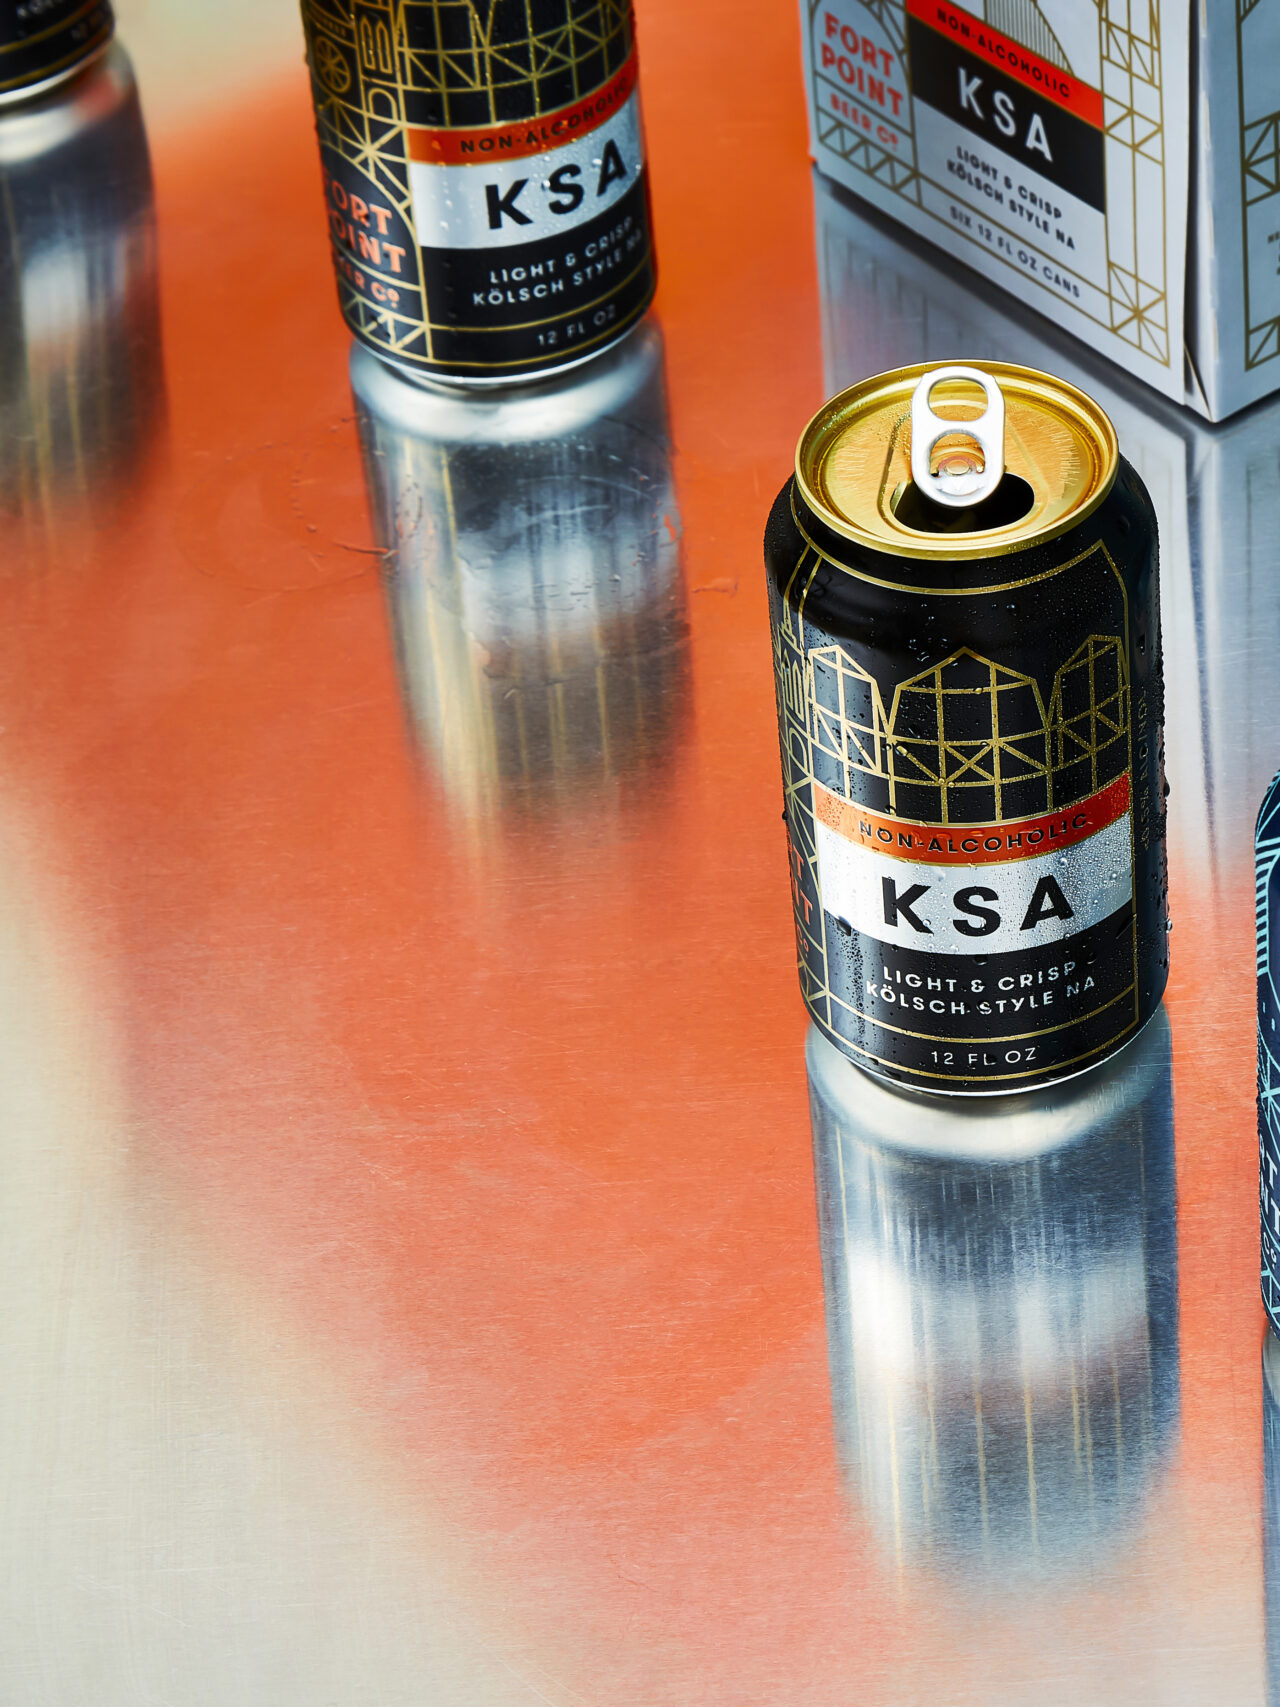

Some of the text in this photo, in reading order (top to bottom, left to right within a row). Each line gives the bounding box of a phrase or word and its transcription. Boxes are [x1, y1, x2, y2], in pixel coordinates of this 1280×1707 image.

[824, 11, 894, 78] FORT
[937, 8, 1070, 98] NON-ALCOHOLIC
[821, 42, 903, 117] POINT
[461, 77, 628, 153] NON-ALCOHOLIC
[830, 93, 872, 132] BEER
[958, 67, 1053, 162] KSA
[326, 172, 392, 235] ORT
[485, 139, 628, 230] KSA
[947, 160, 1075, 250] KÖLSCH STYLE NA
[956, 146, 998, 180] LIGHT
[1018, 185, 1062, 219] CRISP
[331, 210, 406, 273] OINT
[490, 259, 556, 284] LIGHT
[584, 215, 632, 258] CRISP
[950, 206, 1080, 298] SIX 12 FL OZ CANS
[472, 278, 564, 305] KÖLSCH
[572, 248, 623, 286] STYLE
[537, 303, 616, 346] 12 FL OZ
[859, 813, 1088, 853] NON-ALCOHOLIC
[881, 875, 1075, 937] KSA
[866, 976, 1095, 1015] KÖLSCH STYLE NA
[883, 961, 1076, 993] LIGHT & CRISP
[931, 1047, 1037, 1066] 12 FL OZ
